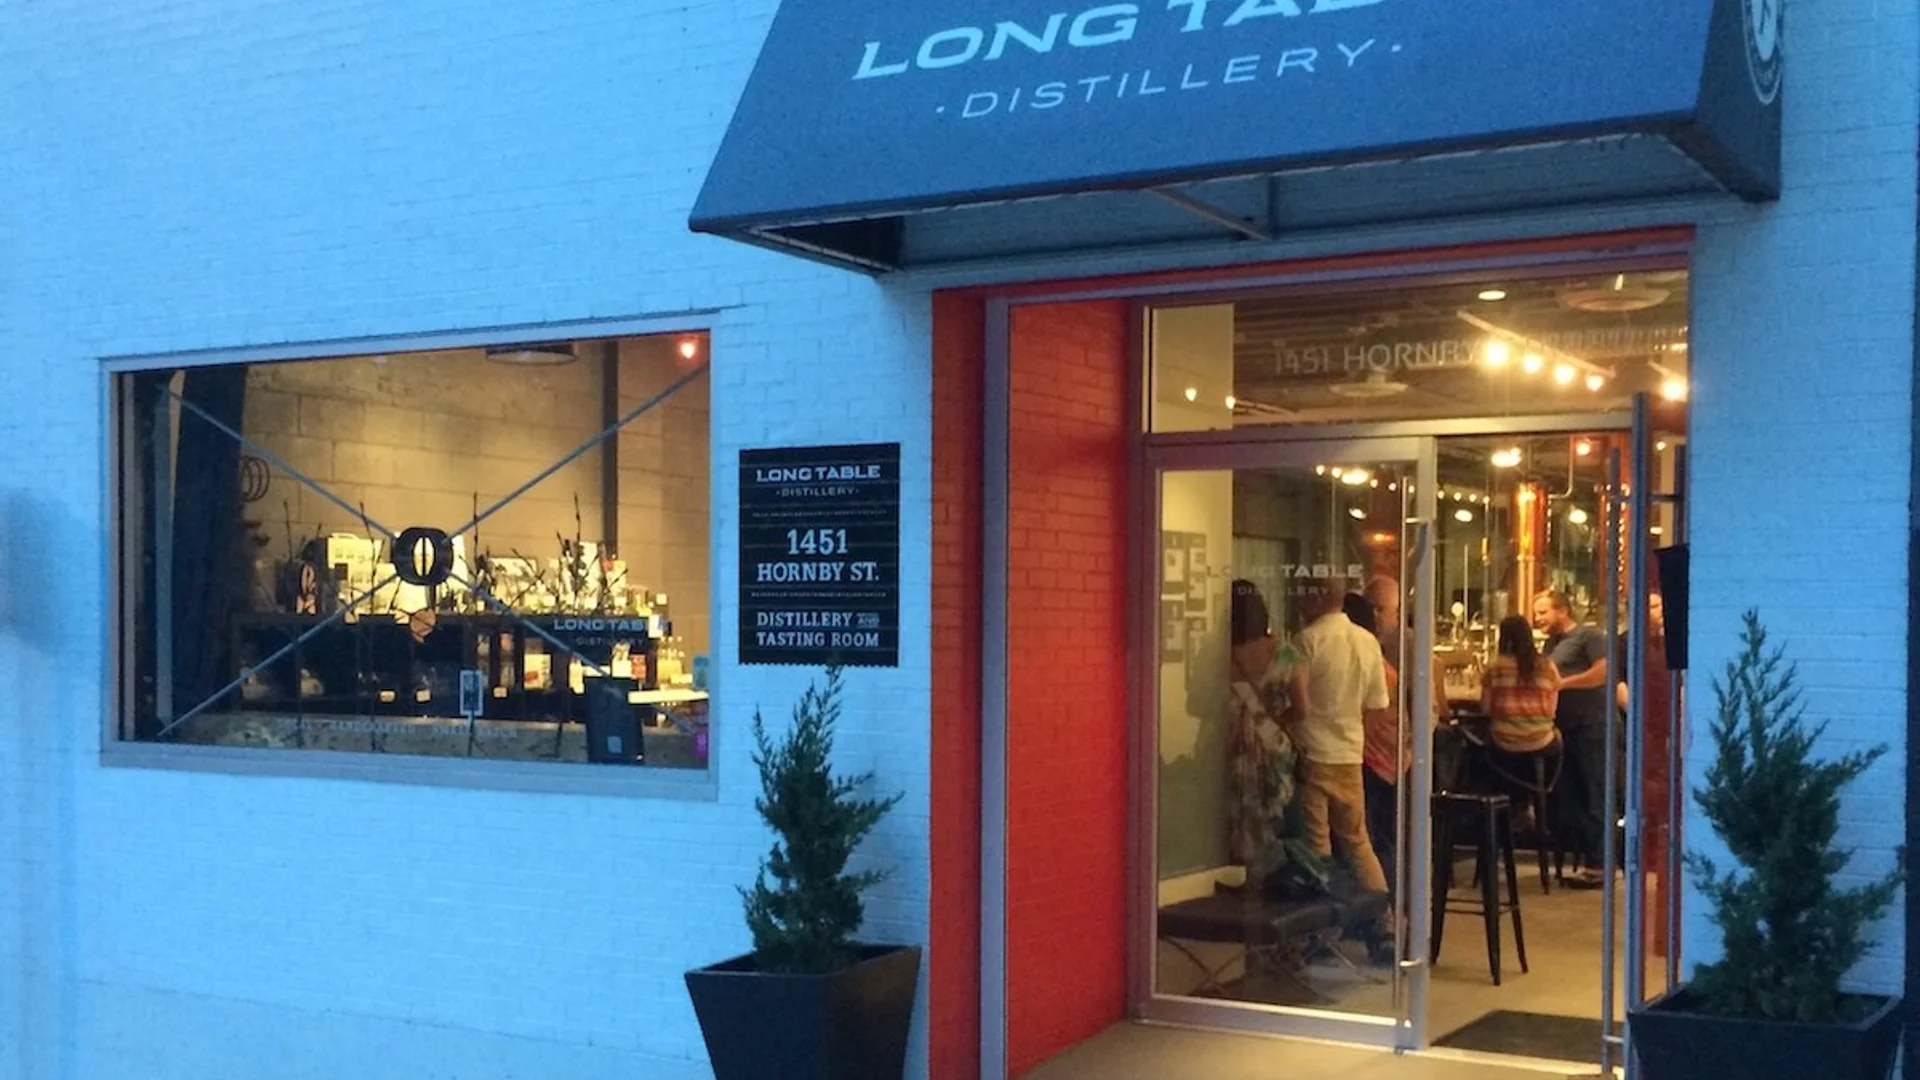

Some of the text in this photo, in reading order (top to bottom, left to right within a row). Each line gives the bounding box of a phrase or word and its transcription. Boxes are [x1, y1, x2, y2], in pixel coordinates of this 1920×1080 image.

[851, 0, 1385, 80] LONG TA
[961, 38, 1377, 118] DISTILLERY
[756, 465, 881, 482] LONG TABLE
[787, 528, 848, 555] 1451
[756, 561, 880, 582] HORNBY ST.
[1281, 564, 1363, 578] TABLE
[553, 618, 605, 631] LONG
[756, 612, 853, 627] DISTILLERY
[756, 631, 879, 646] TASTING ROOM
